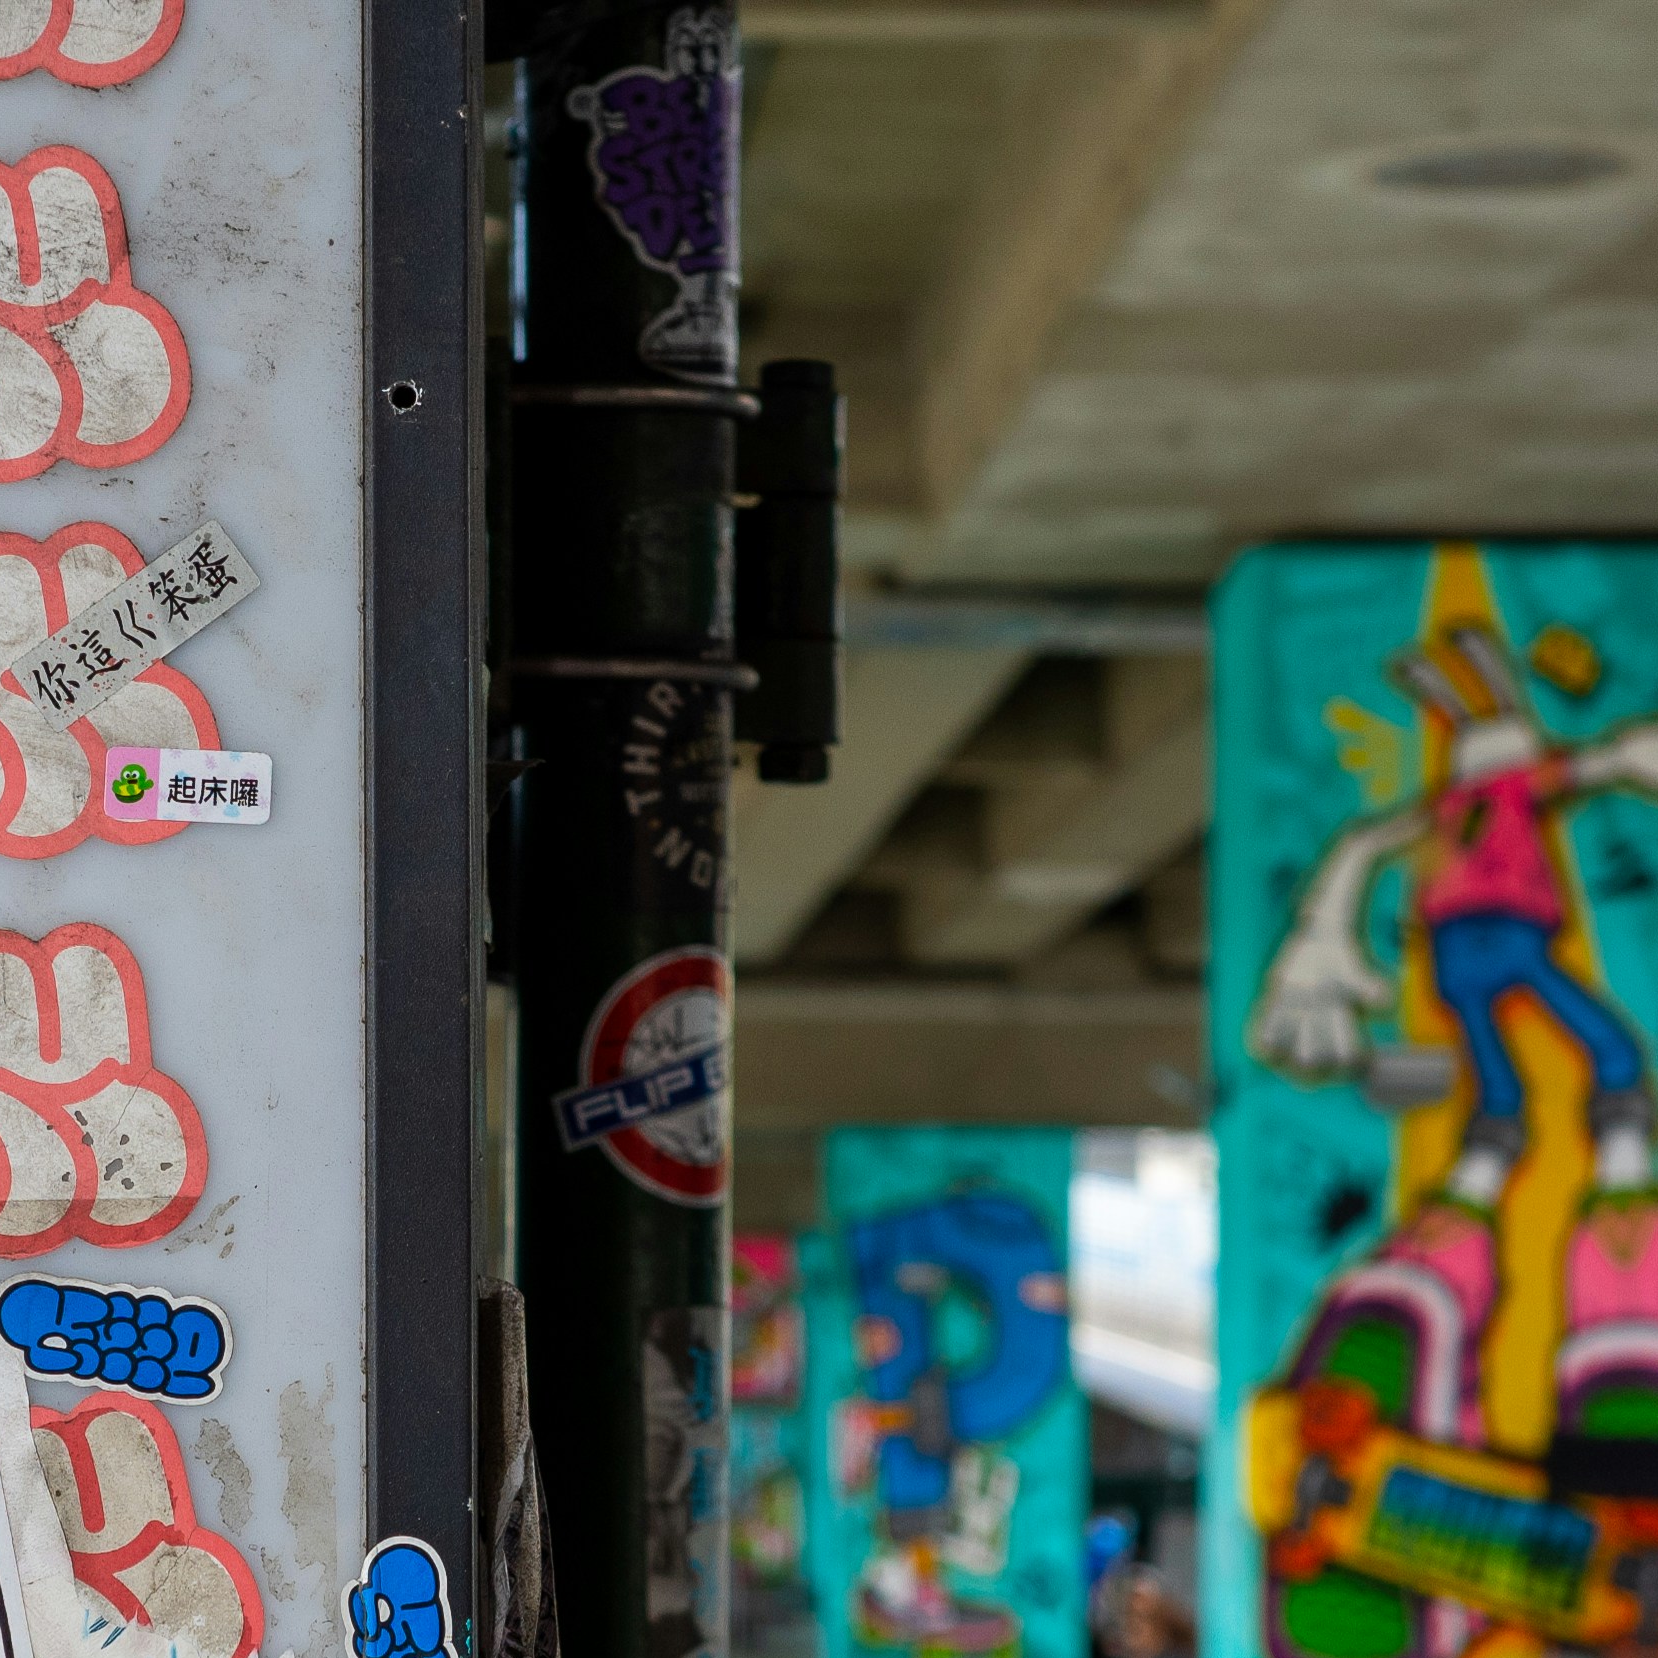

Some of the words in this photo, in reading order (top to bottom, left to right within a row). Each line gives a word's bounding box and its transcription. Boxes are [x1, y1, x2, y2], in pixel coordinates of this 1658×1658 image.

[167, 774, 260, 809] 起床囉
[572, 1063, 695, 1133] FLIP
